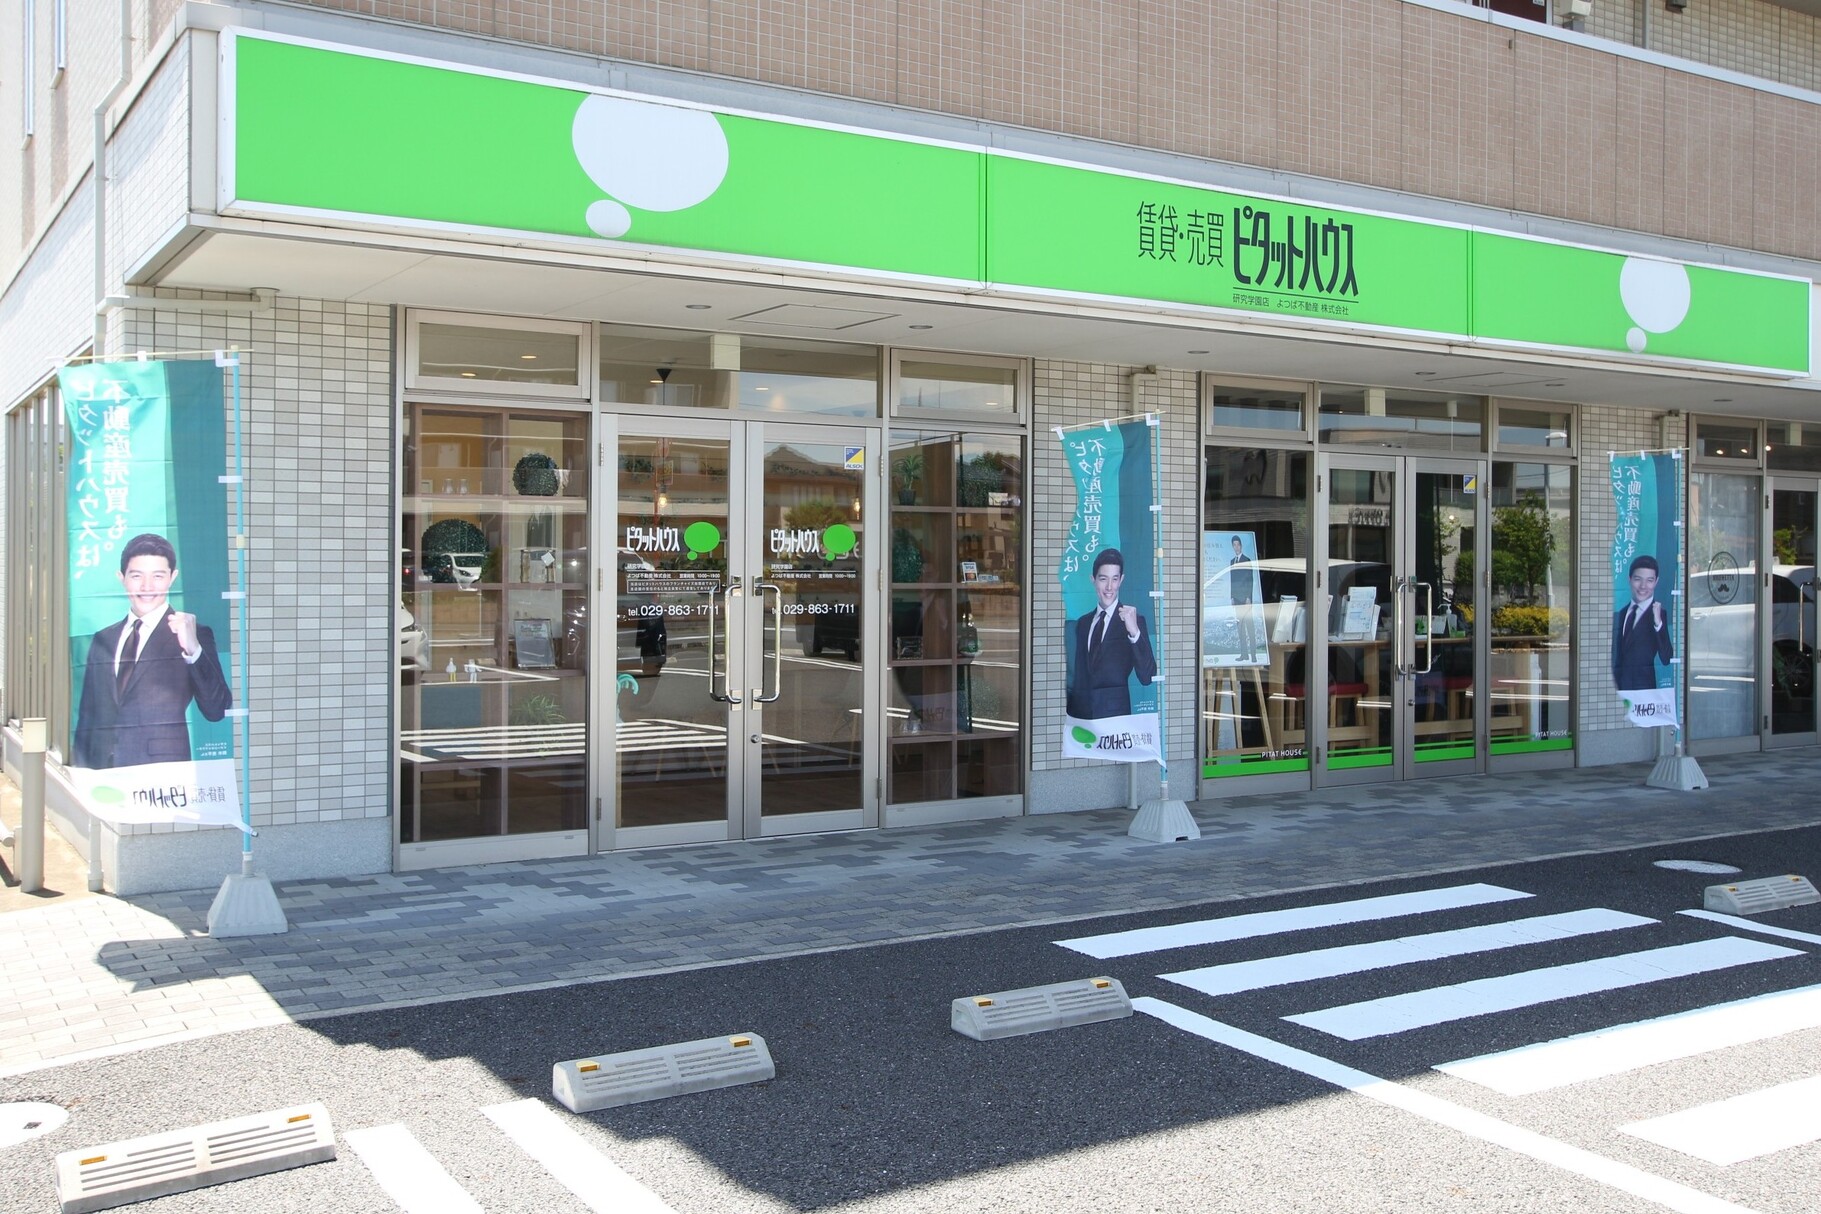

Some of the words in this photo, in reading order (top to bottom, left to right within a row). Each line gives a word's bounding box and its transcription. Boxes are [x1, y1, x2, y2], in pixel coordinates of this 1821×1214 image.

[1136, 200, 1224, 267] 賃貸・売買
[1233, 205, 1359, 297] ピタットハウス
[1232, 293, 1269, 307] 研究学園店
[1276, 298, 1319, 312] よつば不動産
[1320, 304, 1349, 315] 株式会社
[626, 526, 680, 552] ピタットハウス
[770, 529, 820, 553] ピタットハウス
[628, 606, 640, 617] tel.
[640, 604, 719, 616] 029-863-1711
[783, 603, 855, 614] 029-863-1711
[1261, 750, 1279, 758] PITAT
[1280, 748, 1302, 757] HOUSE
